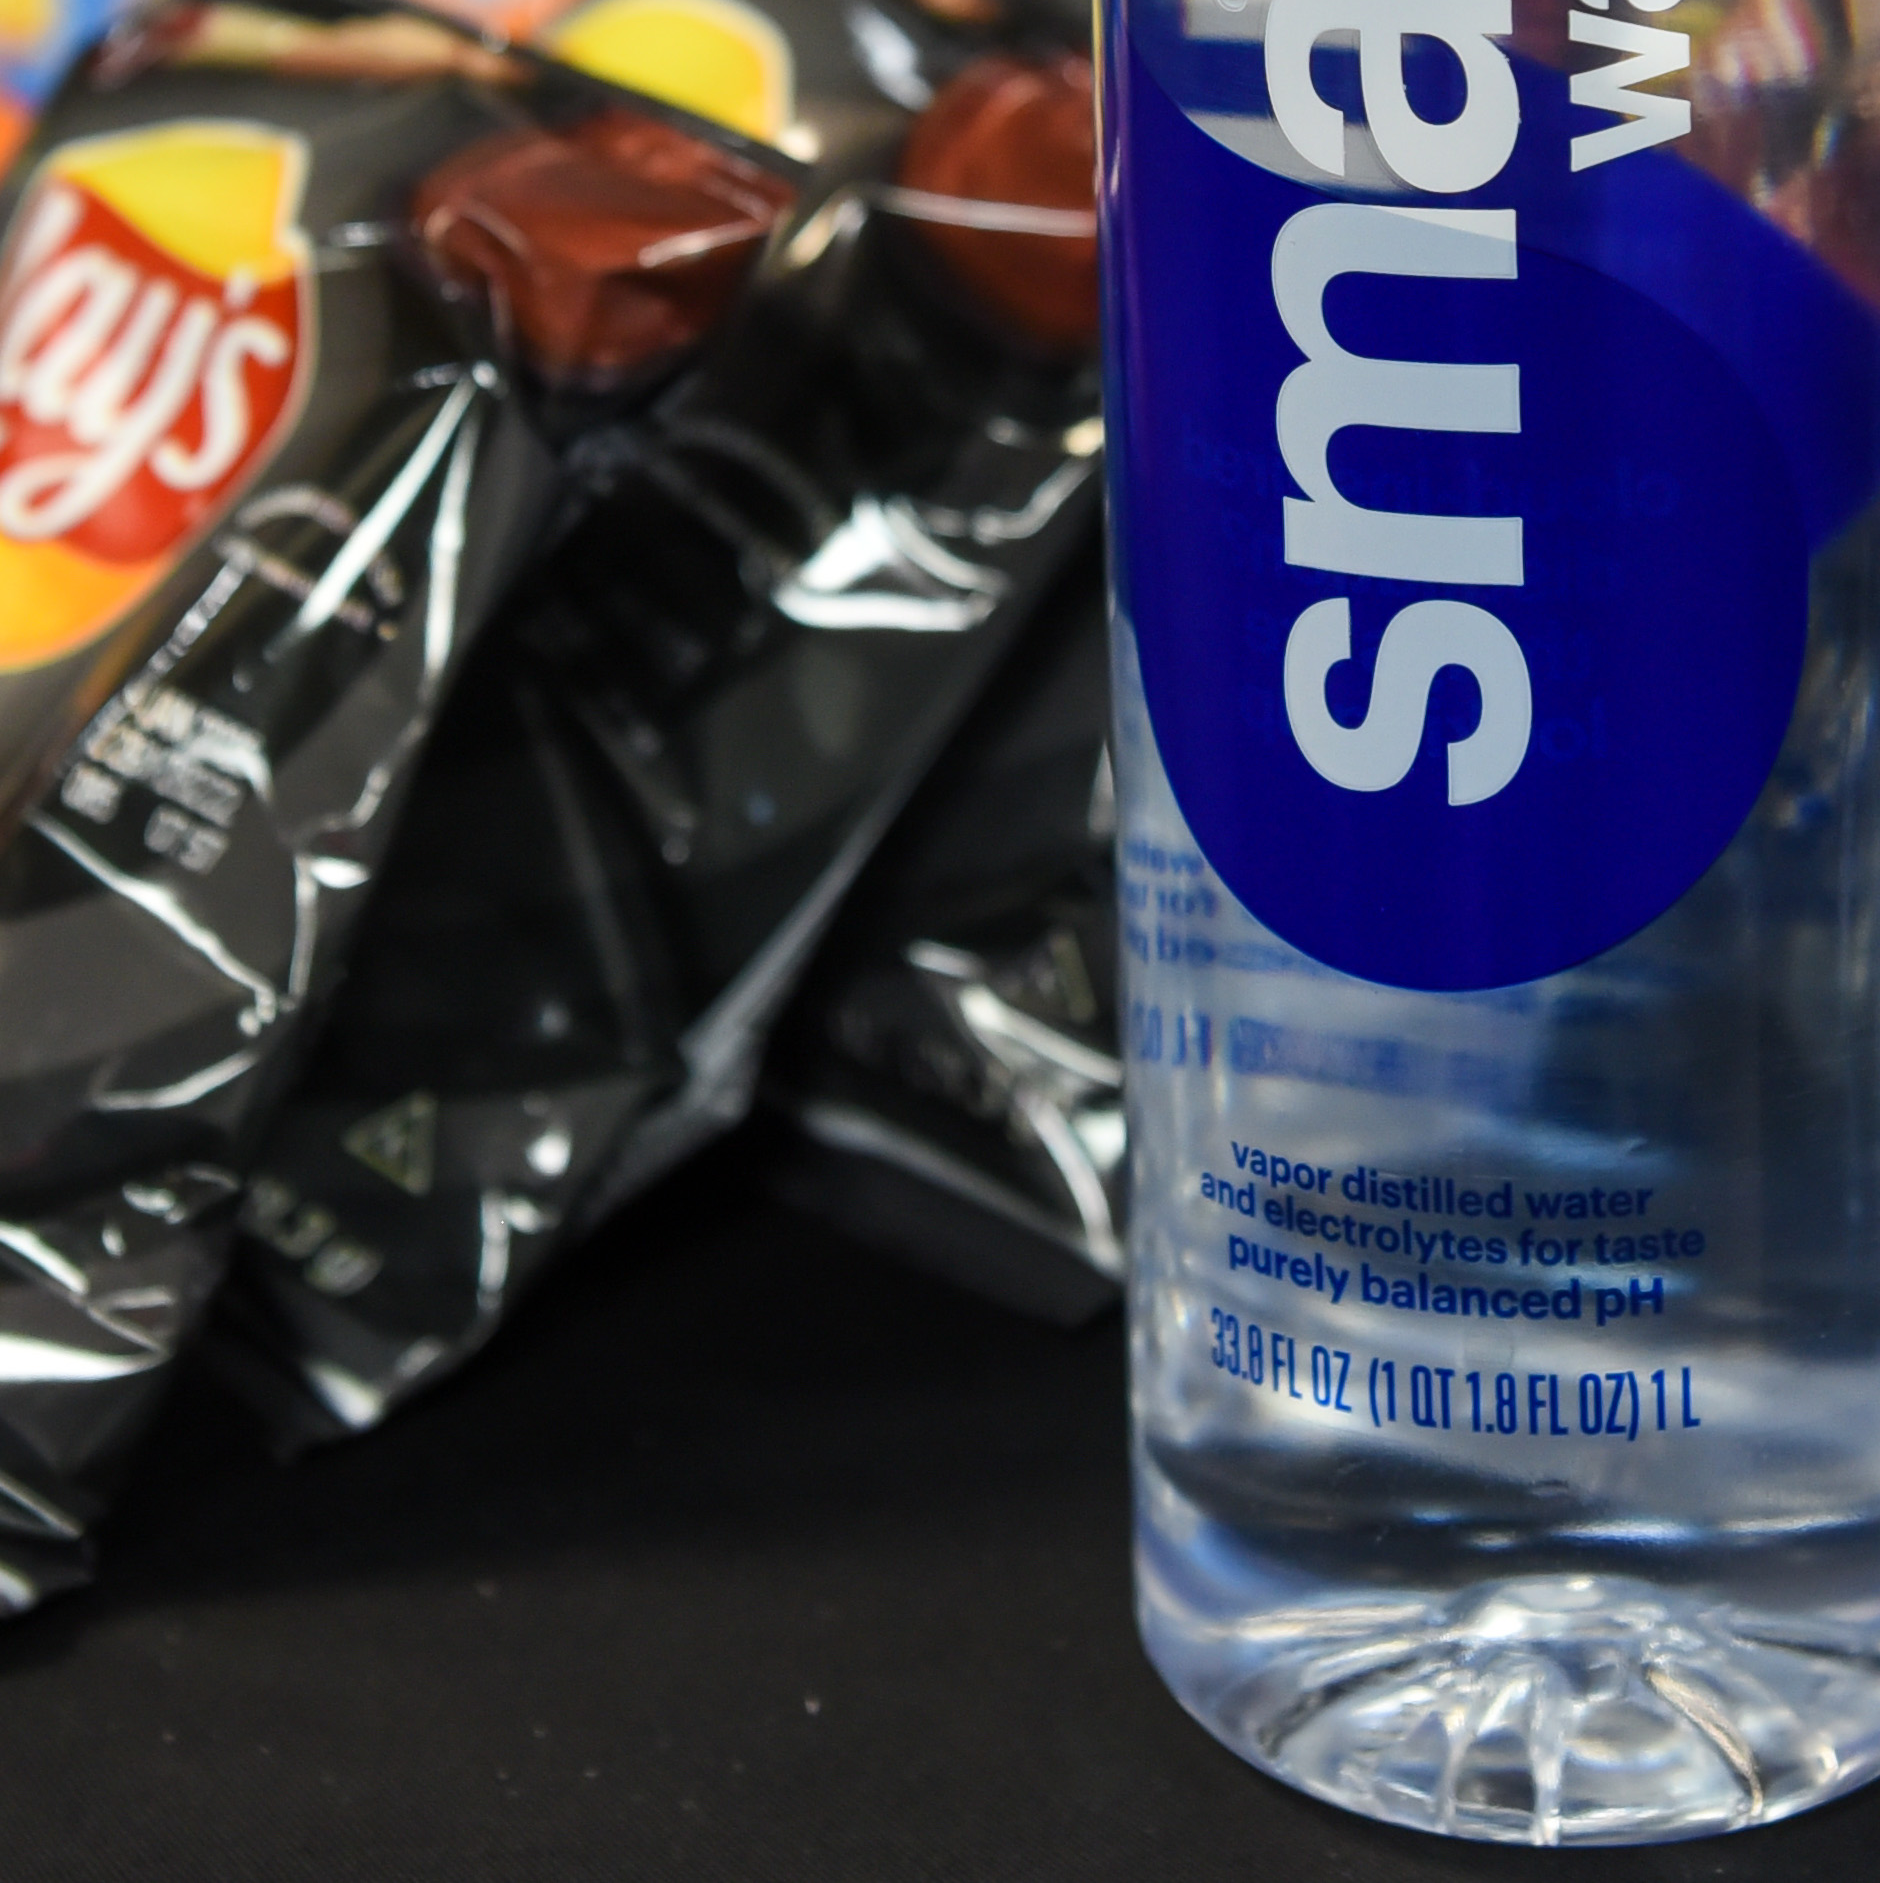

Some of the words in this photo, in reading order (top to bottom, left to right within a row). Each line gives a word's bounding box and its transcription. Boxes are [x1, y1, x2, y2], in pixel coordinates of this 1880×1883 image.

[1200, 1171, 1256, 1218] and
[1263, 1194, 1509, 1265] electrolytes
[1517, 1228, 1584, 1266] for
[1593, 1227, 1706, 1266] taste
[1231, 1140, 1332, 1196] vapor
[1341, 1166, 1513, 1220] distilled
[1524, 1185, 1654, 1220] water
[1228, 1233, 1350, 1305] purely
[1361, 1262, 1583, 1321] balanced
[1595, 1275, 1664, 1328] pH
[1211, 1306, 1263, 1386] 33.8
[1271, 1331, 1303, 1400] FL
[1311, 1344, 1353, 1413] OZ
[1368, 1356, 1397, 1428] (1
[1410, 1363, 1456, 1430] QT
[1465, 1370, 1518, 1436] 1.8
[1528, 1373, 1570, 1437] FL
[1578, 1370, 1640, 1442] OZ)
[1650, 1368, 1667, 1432] 1
[1681, 1365, 1702, 1429] L
